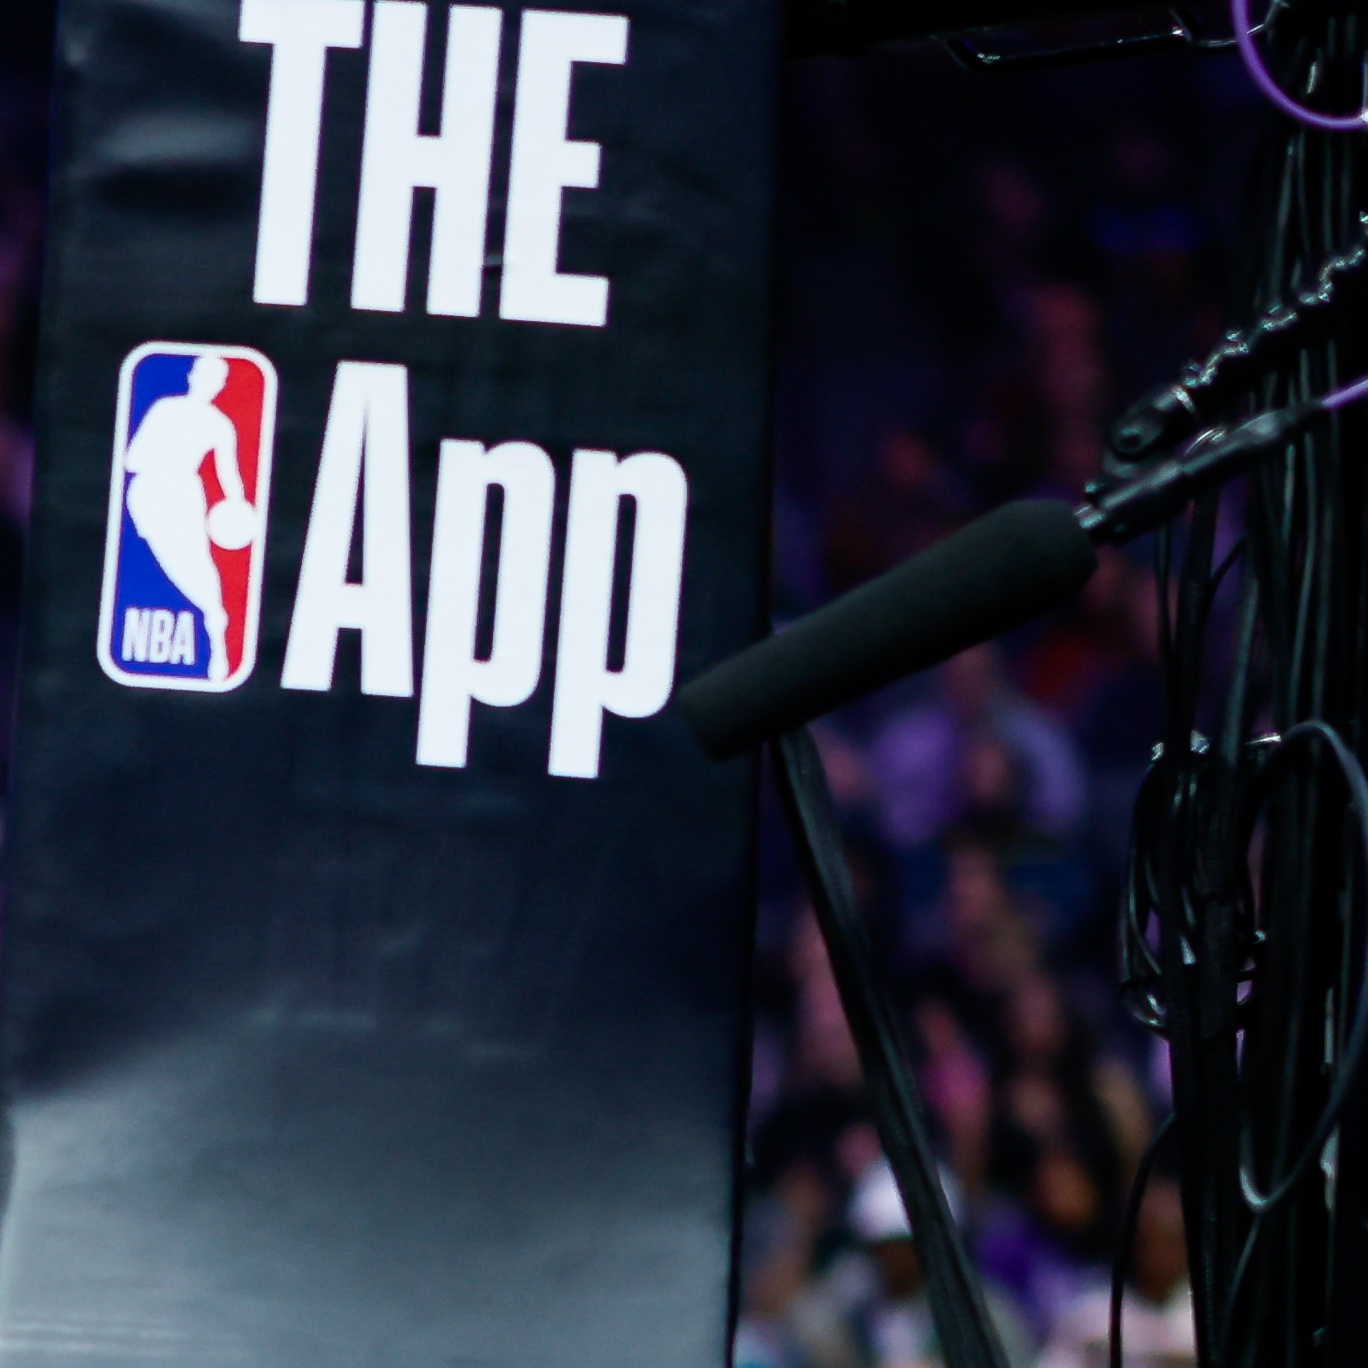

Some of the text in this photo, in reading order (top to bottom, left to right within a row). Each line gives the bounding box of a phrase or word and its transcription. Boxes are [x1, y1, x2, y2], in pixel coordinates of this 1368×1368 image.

[238, 0, 629, 327] THE
[122, 361, 688, 778] NBA App
